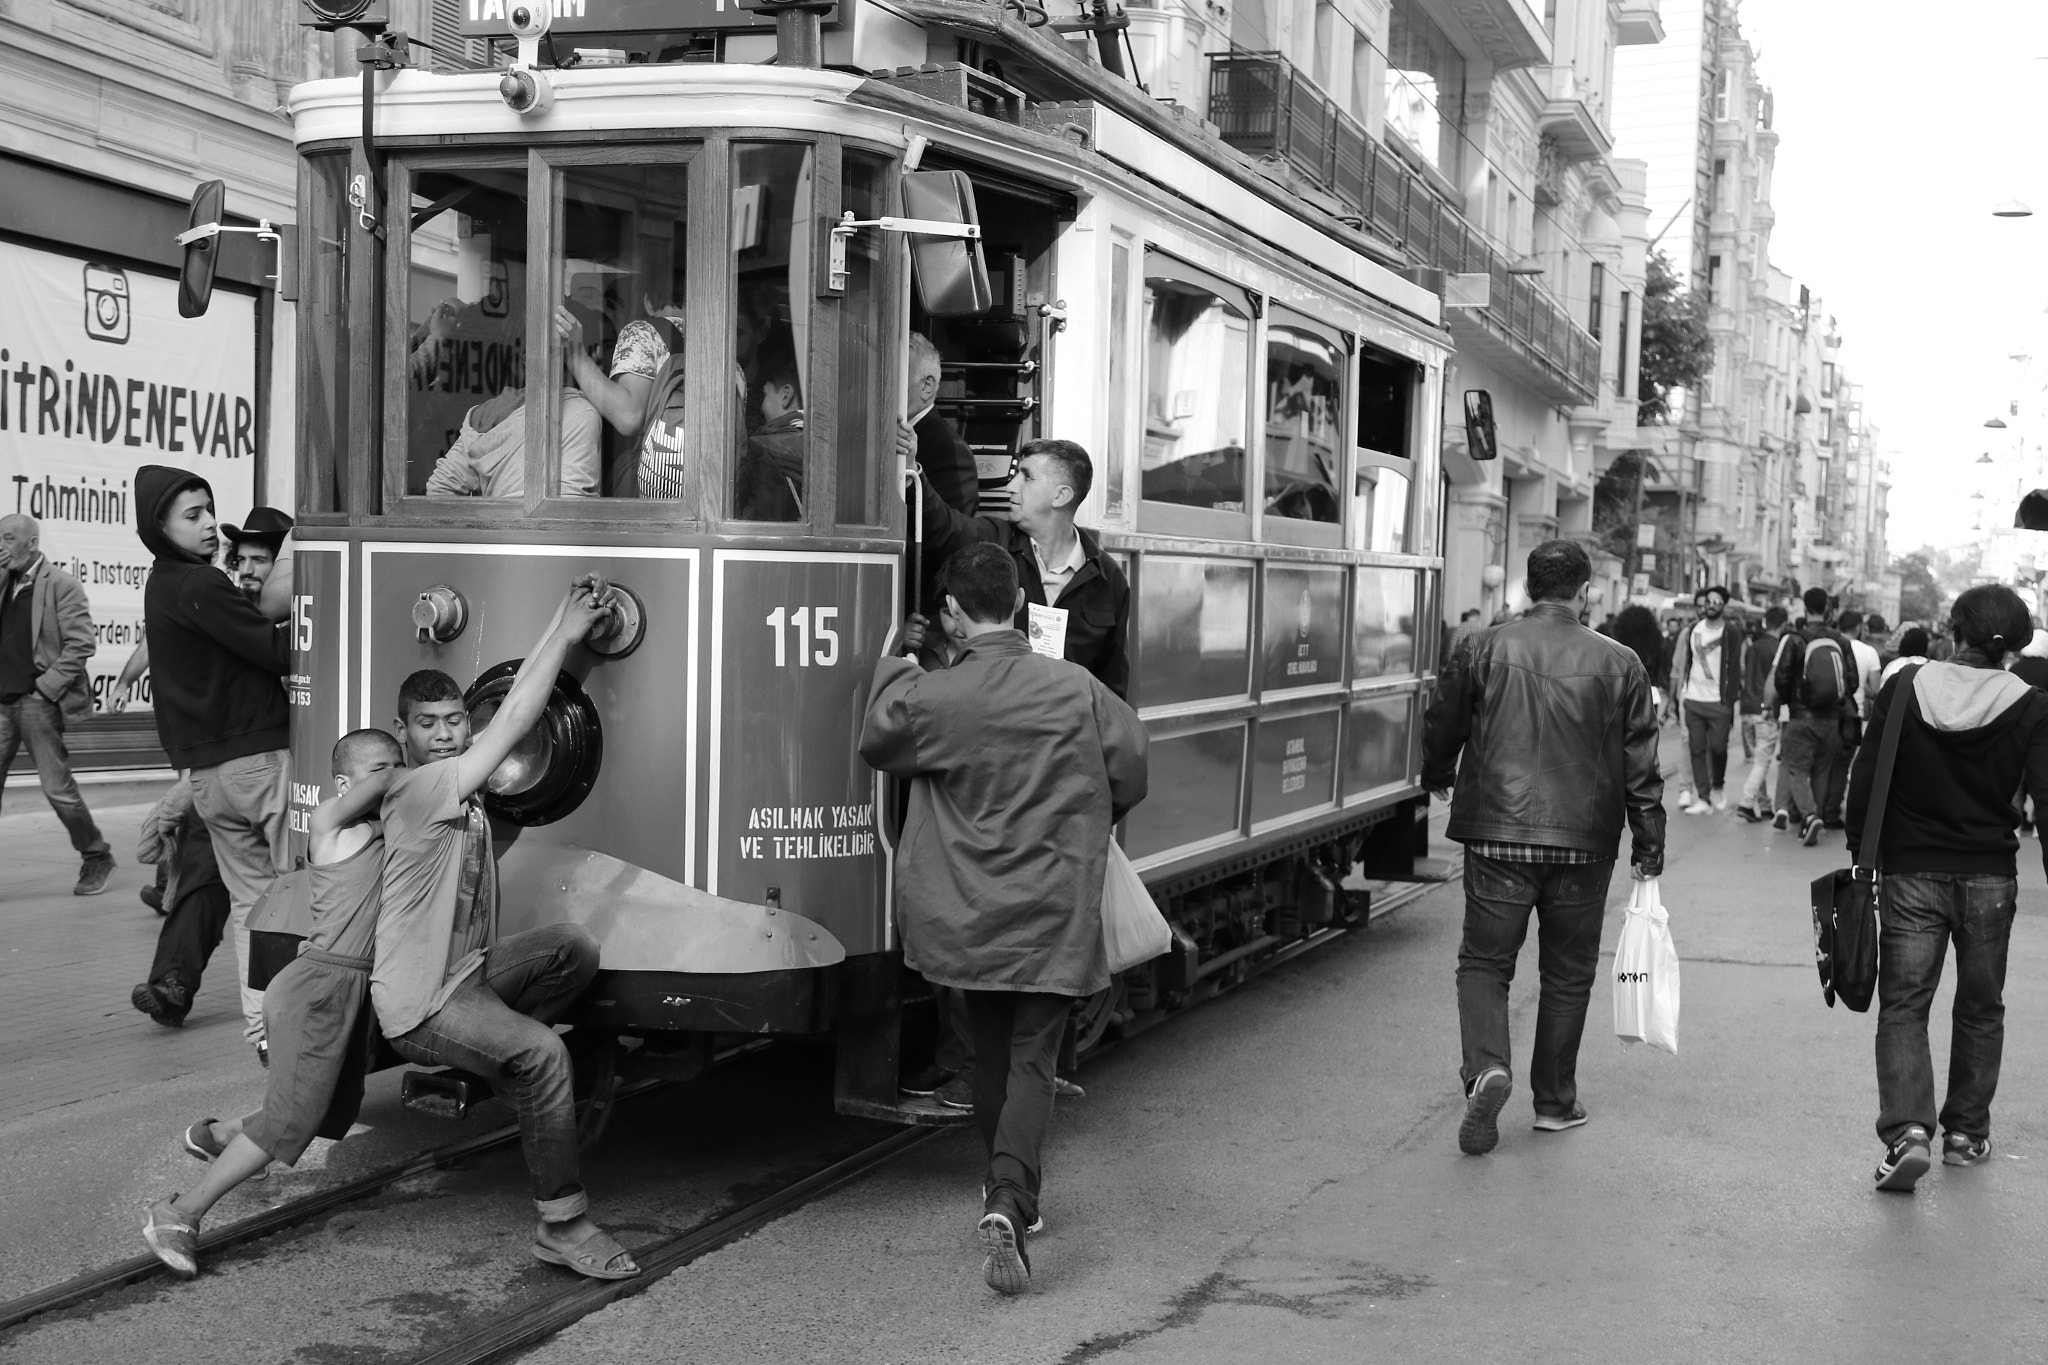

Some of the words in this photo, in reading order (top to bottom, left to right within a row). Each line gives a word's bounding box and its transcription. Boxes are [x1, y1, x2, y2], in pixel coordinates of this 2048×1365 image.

[12, 474, 127, 525] Tahminini
[766, 606, 839, 667] 115
[297, 691, 311, 706] 153
[292, 781, 321, 807] YASAK
[748, 806, 824, 830] ASILMAK
[831, 803, 872, 828] YASAK
[740, 836, 764, 860] VE
[772, 829, 874, 860] TEHLİKELİDİR
